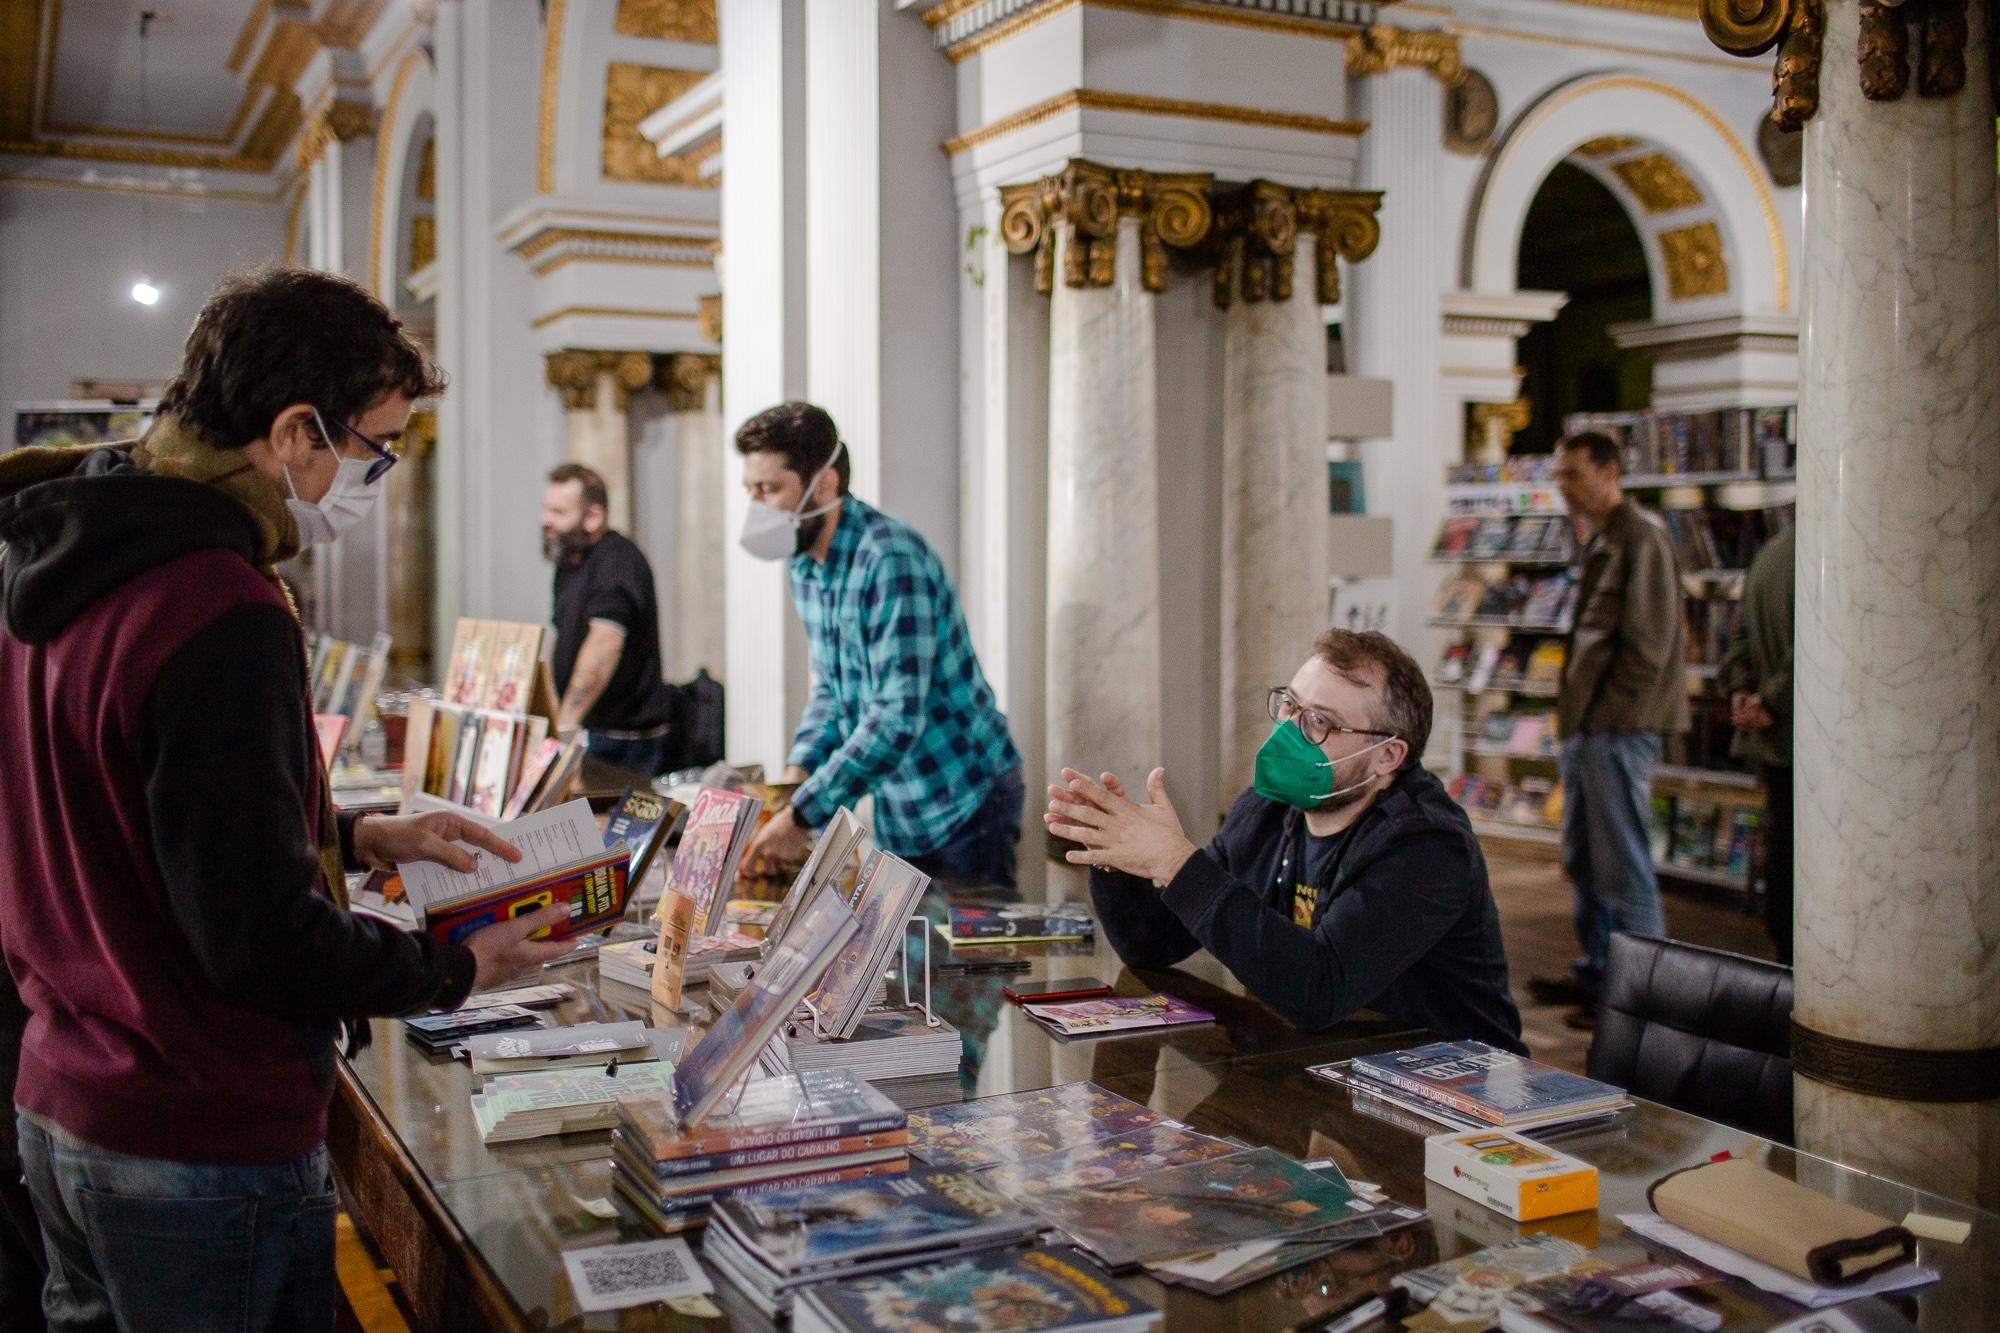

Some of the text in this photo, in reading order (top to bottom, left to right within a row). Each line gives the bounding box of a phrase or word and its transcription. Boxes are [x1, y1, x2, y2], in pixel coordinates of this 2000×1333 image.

[1401, 1079, 1419, 1093] LUGAR
[793, 1127, 823, 1140] LUGAR
[825, 1124, 840, 1136] UM
[730, 1141, 840, 1166] UM LUGAR DO CARALHO
